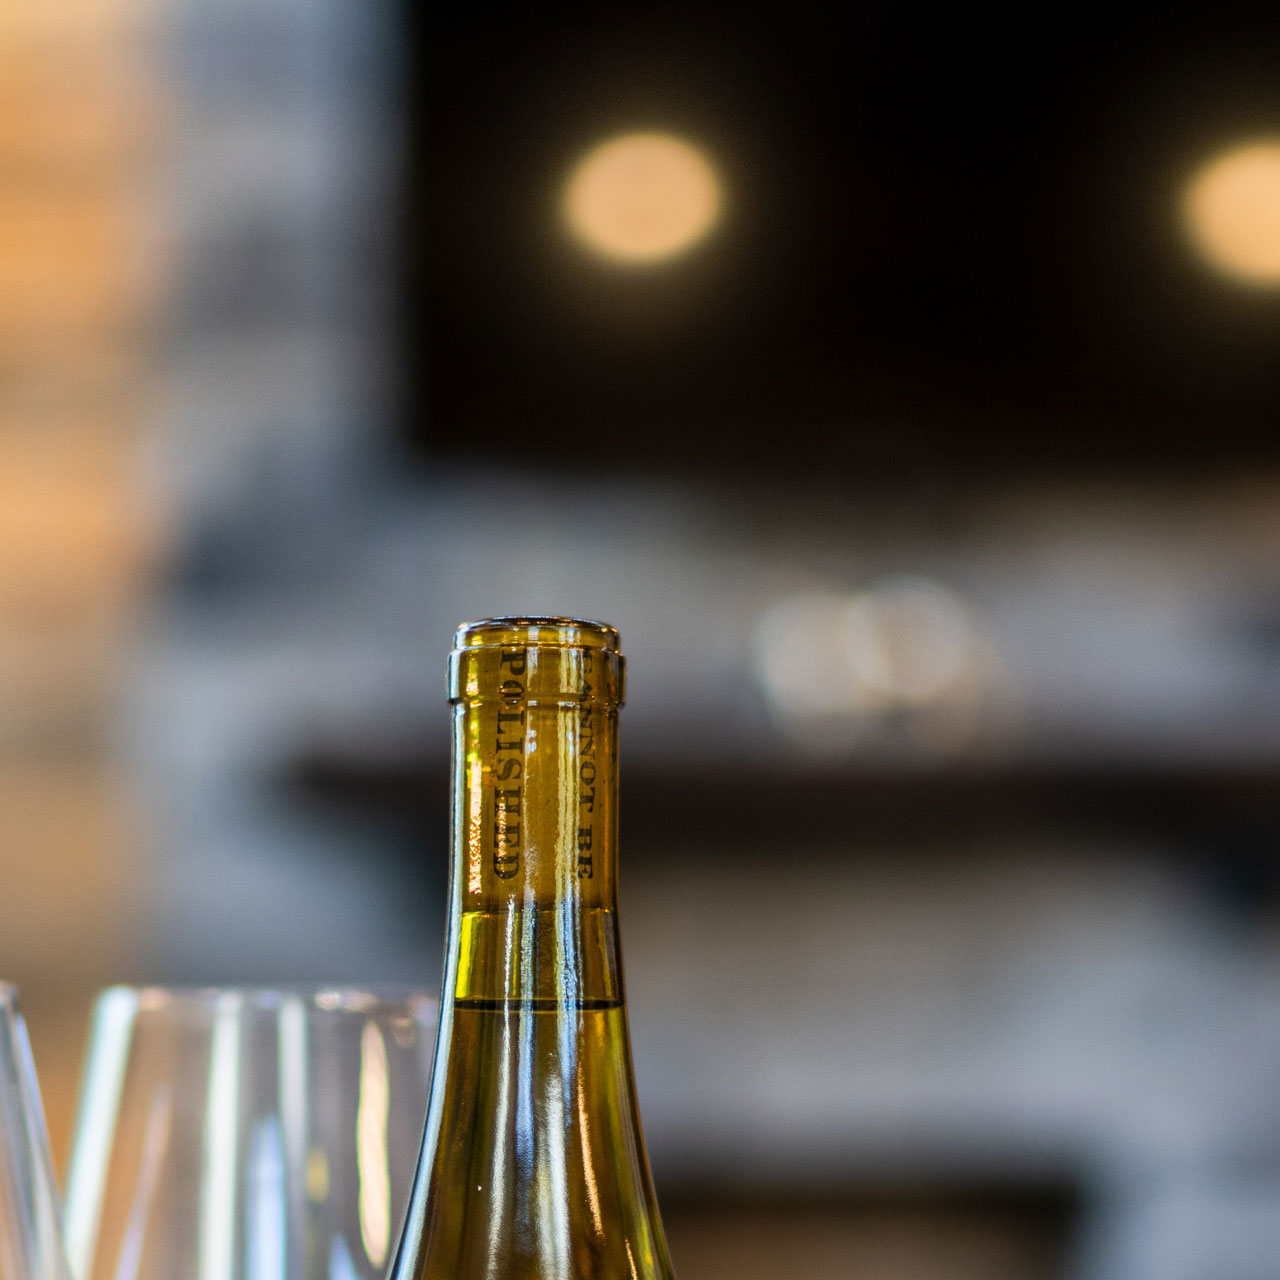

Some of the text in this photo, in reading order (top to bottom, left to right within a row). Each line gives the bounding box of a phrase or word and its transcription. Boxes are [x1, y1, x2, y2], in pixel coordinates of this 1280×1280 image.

[494, 649, 527, 880] POLISHED
[577, 651, 597, 880] CANNOT BE
